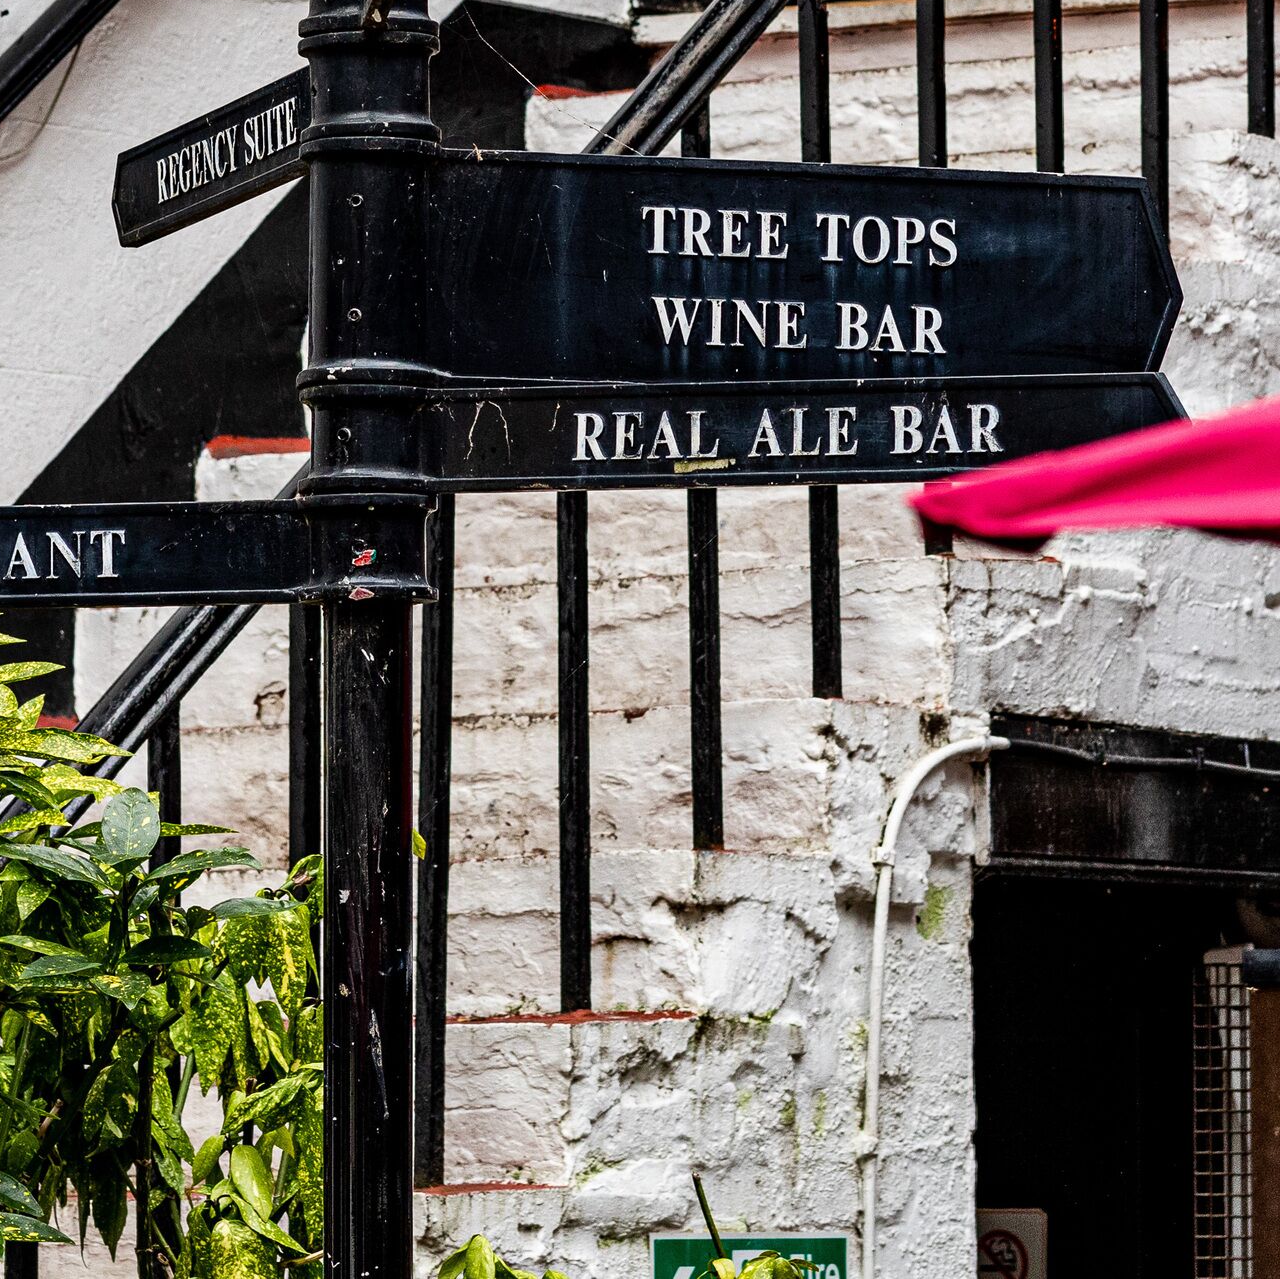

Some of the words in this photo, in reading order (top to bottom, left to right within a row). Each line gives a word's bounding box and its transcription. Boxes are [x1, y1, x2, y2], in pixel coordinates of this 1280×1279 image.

[156, 124, 238, 205] REGENCY
[242, 96, 297, 166] SUITE
[641, 205, 789, 260] TREE
[816, 211, 958, 267] TOPS
[650, 296, 808, 350] WINE
[835, 302, 947, 355] BAR
[571, 408, 720, 463] REAL
[747, 405, 858, 458] ALE
[888, 402, 1005, 456] BAR
